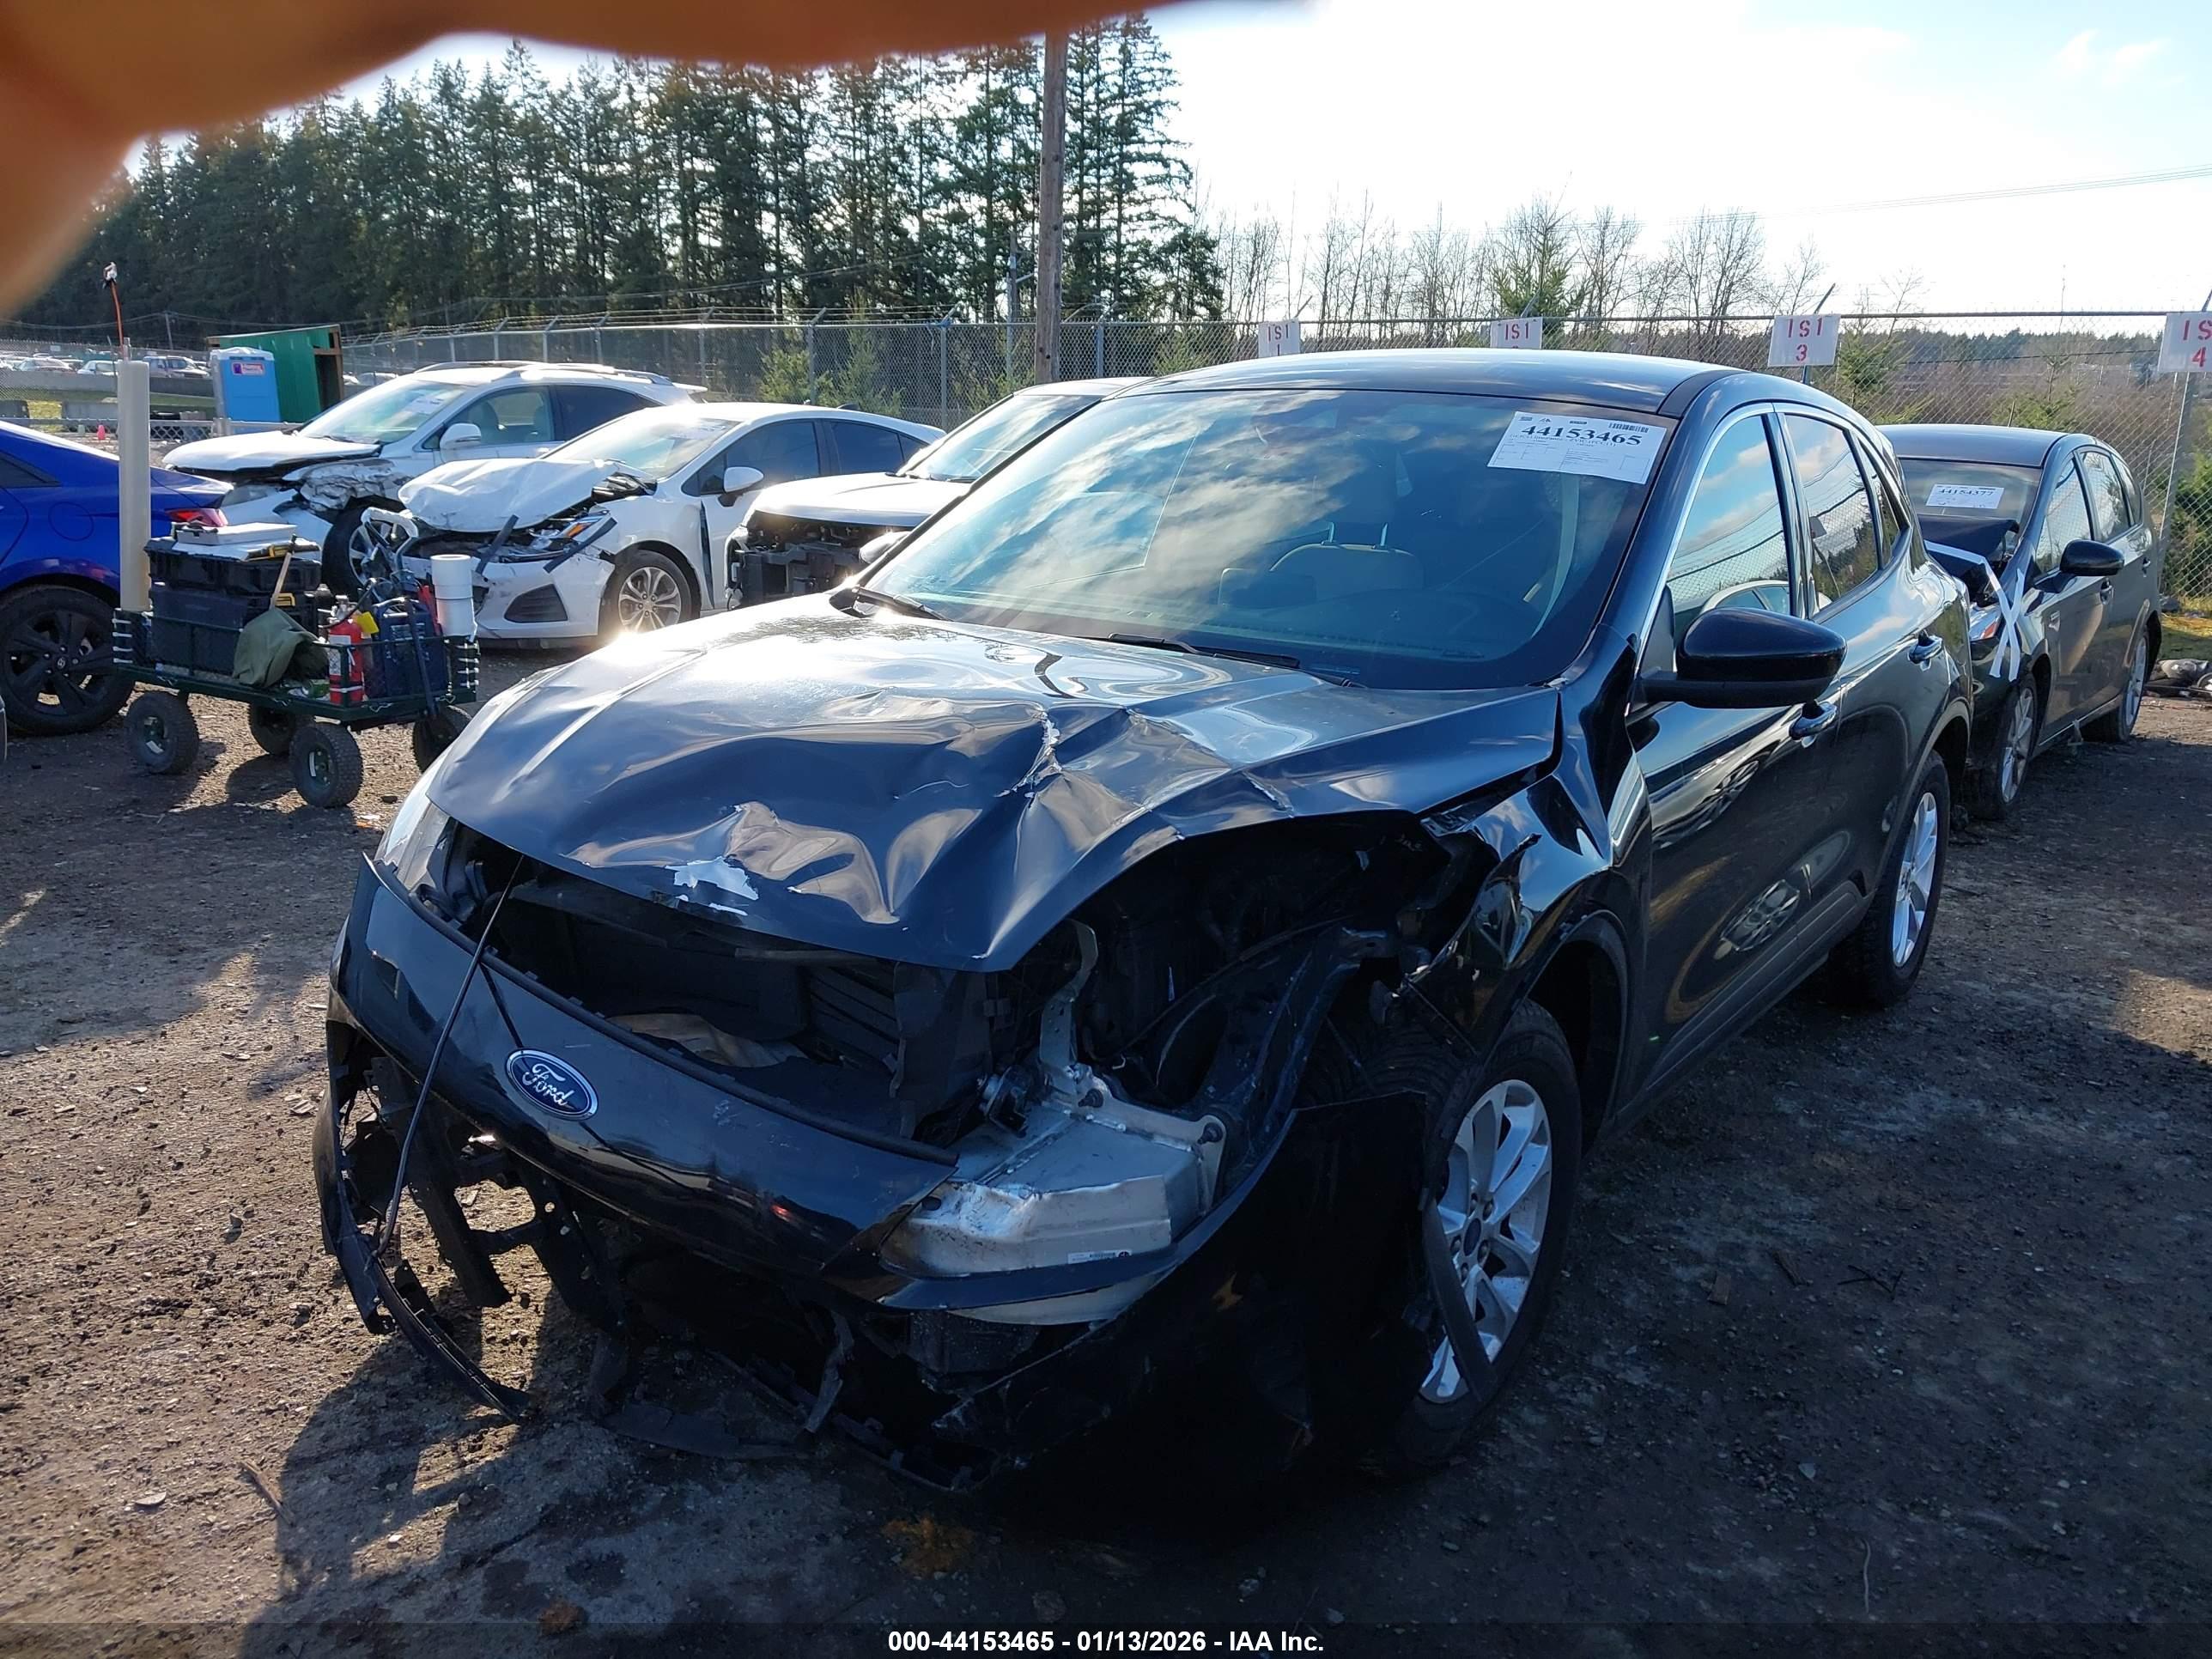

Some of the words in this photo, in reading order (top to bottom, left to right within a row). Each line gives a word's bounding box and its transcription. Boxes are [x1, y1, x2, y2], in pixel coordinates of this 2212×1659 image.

[2183, 319, 2212, 341] IS
[1796, 344, 1808, 362] 3
[2191, 346, 2207, 368] 4
[1521, 425, 1643, 446] 44153465
[521, 1062, 575, 1106] Ford
